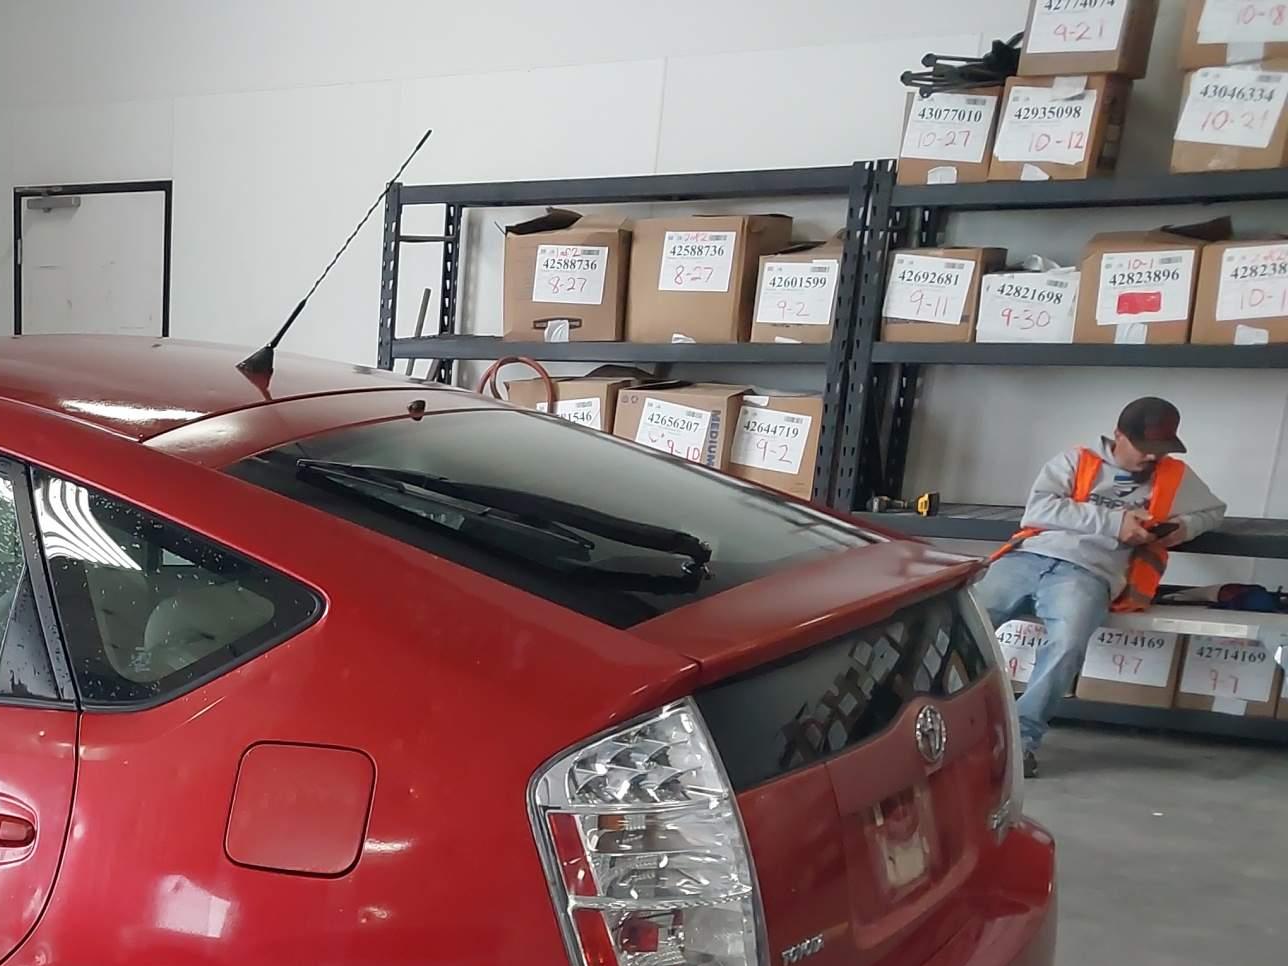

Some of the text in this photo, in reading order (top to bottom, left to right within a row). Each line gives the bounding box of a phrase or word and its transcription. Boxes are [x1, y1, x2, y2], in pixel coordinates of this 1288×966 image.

[1199, 84, 1275, 102] 43046334
[918, 107, 983, 122] 43077010
[1014, 105, 1082, 120] 42935098
[918, 129, 971, 148] 10-27
[1028, 131, 1085, 152] 10-12
[670, 244, 724, 257] 42588736
[543, 258, 597, 271] 42588736
[1127, 258, 1154, 270] 10-1
[549, 275, 588, 294] 8-27
[674, 264, 714, 286] 8-27
[768, 276, 827, 289] 42601599
[898, 269, 960, 286] 42692681
[1109, 267, 1180, 286] 42823896
[910, 289, 949, 317] 9-11
[996, 283, 1063, 304] 42821698
[777, 300, 810, 319] 9-2
[1001, 307, 1051, 330] 9-30
[648, 412, 700, 432] 42656207
[743, 419, 800, 439] 42644719
[706, 409, 722, 467] MEDIUM
[756, 438, 793, 464] 9-2
[1097, 631, 1165, 649] 42714169
[1196, 647, 1266, 664] 42714169
